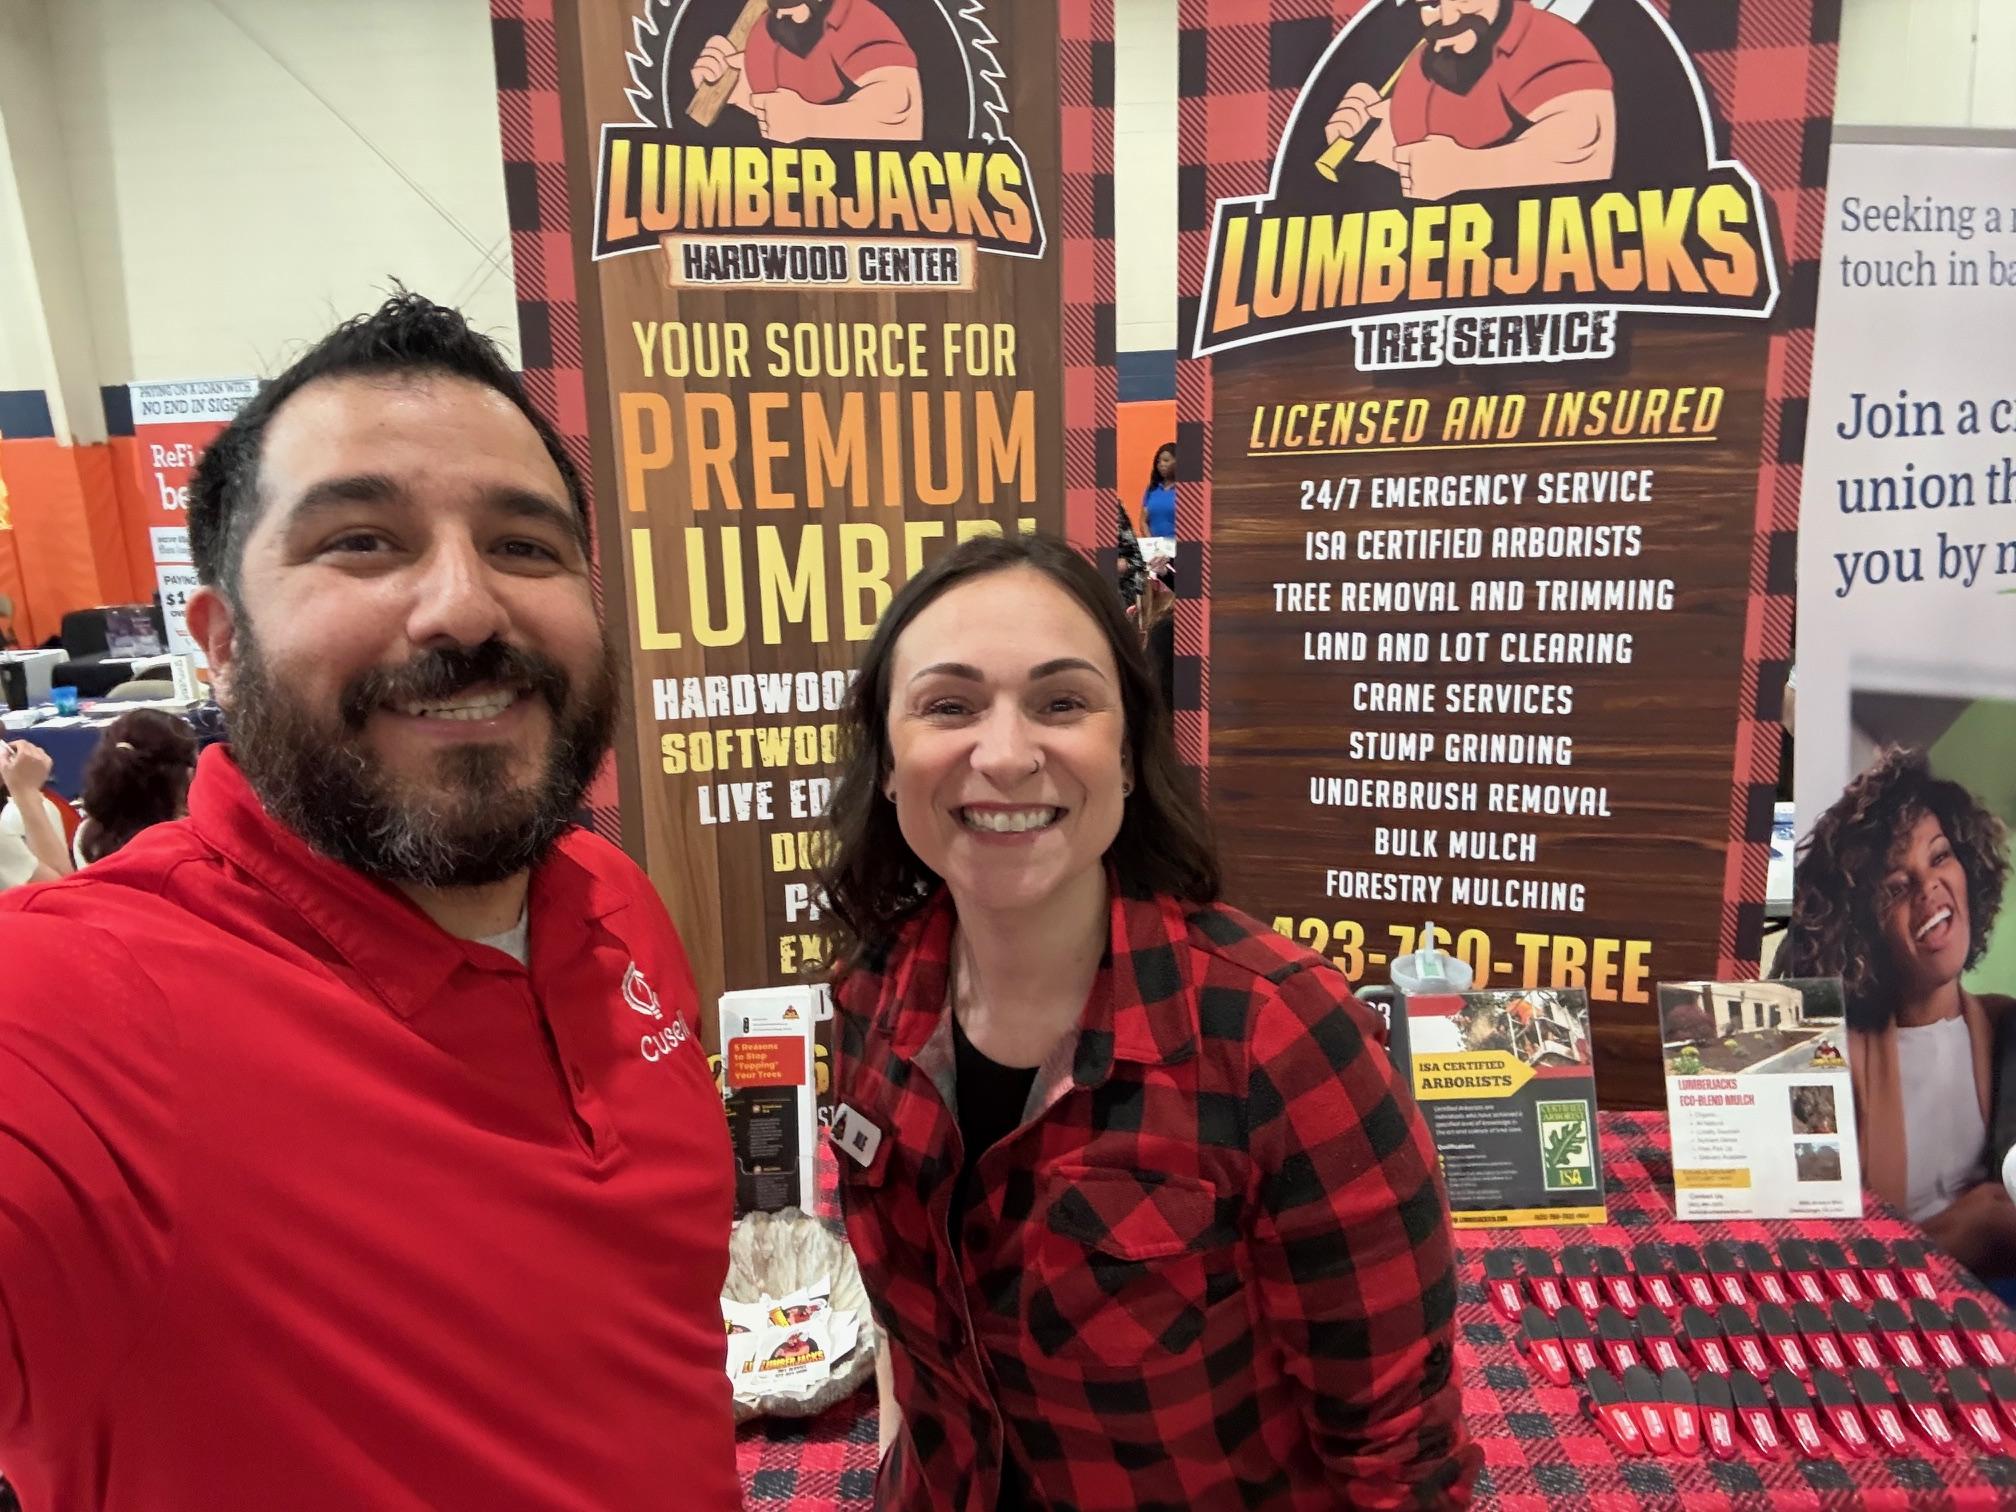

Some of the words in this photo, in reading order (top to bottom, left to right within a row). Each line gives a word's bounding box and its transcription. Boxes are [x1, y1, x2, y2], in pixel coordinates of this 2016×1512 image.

[605, 139, 1033, 244] LUMBERJACKS
[1841, 196, 1975, 240] Seeking
[1985, 207, 2001, 233] a
[683, 244, 848, 282] HARDWOOD
[858, 246, 959, 284] CENTER
[1212, 184, 1759, 333] LUMBERJACKS
[1841, 250, 1937, 287] touch
[1948, 251, 1979, 286] in
[632, 321, 751, 378] YOUR
[765, 322, 928, 377] SOURCE
[943, 323, 1016, 377] FOR
[1358, 320, 1439, 365] TREE
[1453, 310, 1610, 359] SERVICE
[143, 401, 161, 415] NO
[164, 400, 189, 414] END
[191, 399, 205, 413] IN
[1250, 398, 1429, 449] LICENSED
[1442, 394, 1526, 442] AND
[1538, 387, 1724, 438] INSURED
[1837, 390, 1944, 440] Join
[1957, 400, 1980, 434] a
[619, 390, 1036, 512] PREMIUM
[1301, 478, 1360, 510] 24/7
[1370, 473, 1527, 509] EMERGENCY
[1538, 470, 1653, 503] SERVICE
[1837, 463, 1975, 513] union
[1306, 531, 1346, 560] ISA
[1357, 528, 1482, 559] CERTIFIED
[1492, 525, 1642, 558] ARBORISTS
[631, 517, 1036, 650] LUMBE
[1834, 547, 1924, 597] you
[1938, 532, 1986, 587] by
[1274, 583, 1330, 612] TREE
[1342, 581, 1460, 612] REMOVAL
[1470, 581, 1524, 611] AND
[1536, 579, 1674, 611] TRIMMING
[1304, 632, 1366, 661] LAND
[1378, 632, 1429, 662] AND
[1440, 632, 1490, 662] LOT
[1500, 633, 1633, 664] CLEARING
[1353, 683, 1435, 712] CRANE
[1446, 684, 1573, 715] SERVICES
[1350, 731, 1434, 762] STUMP
[1445, 733, 1573, 766] GRINDING
[698, 781, 775, 825] LIVE
[789, 777, 844, 818] ED
[1310, 777, 1477, 811] UNDERBRUSH
[1488, 783, 1611, 817] REMOVAL
[1374, 828, 1438, 857] BULK
[1449, 830, 1537, 862] MULCH
[1326, 870, 1443, 904] FORESTRY
[1452, 876, 1585, 912] MULCHING
[742, 1043, 778, 1051] Reasons
[746, 1052, 768, 1061] Stop
[1419, 1063, 1440, 1072] ISA
[1443, 1061, 1505, 1071] CERTIFIED
[1422, 1075, 1512, 1089] ARBORISTS
[1678, 1079, 1737, 1090] LUMBERJACKS
[1725, 1094, 1755, 1105] MULCH
[1560, 1168, 1583, 1185] ISA
